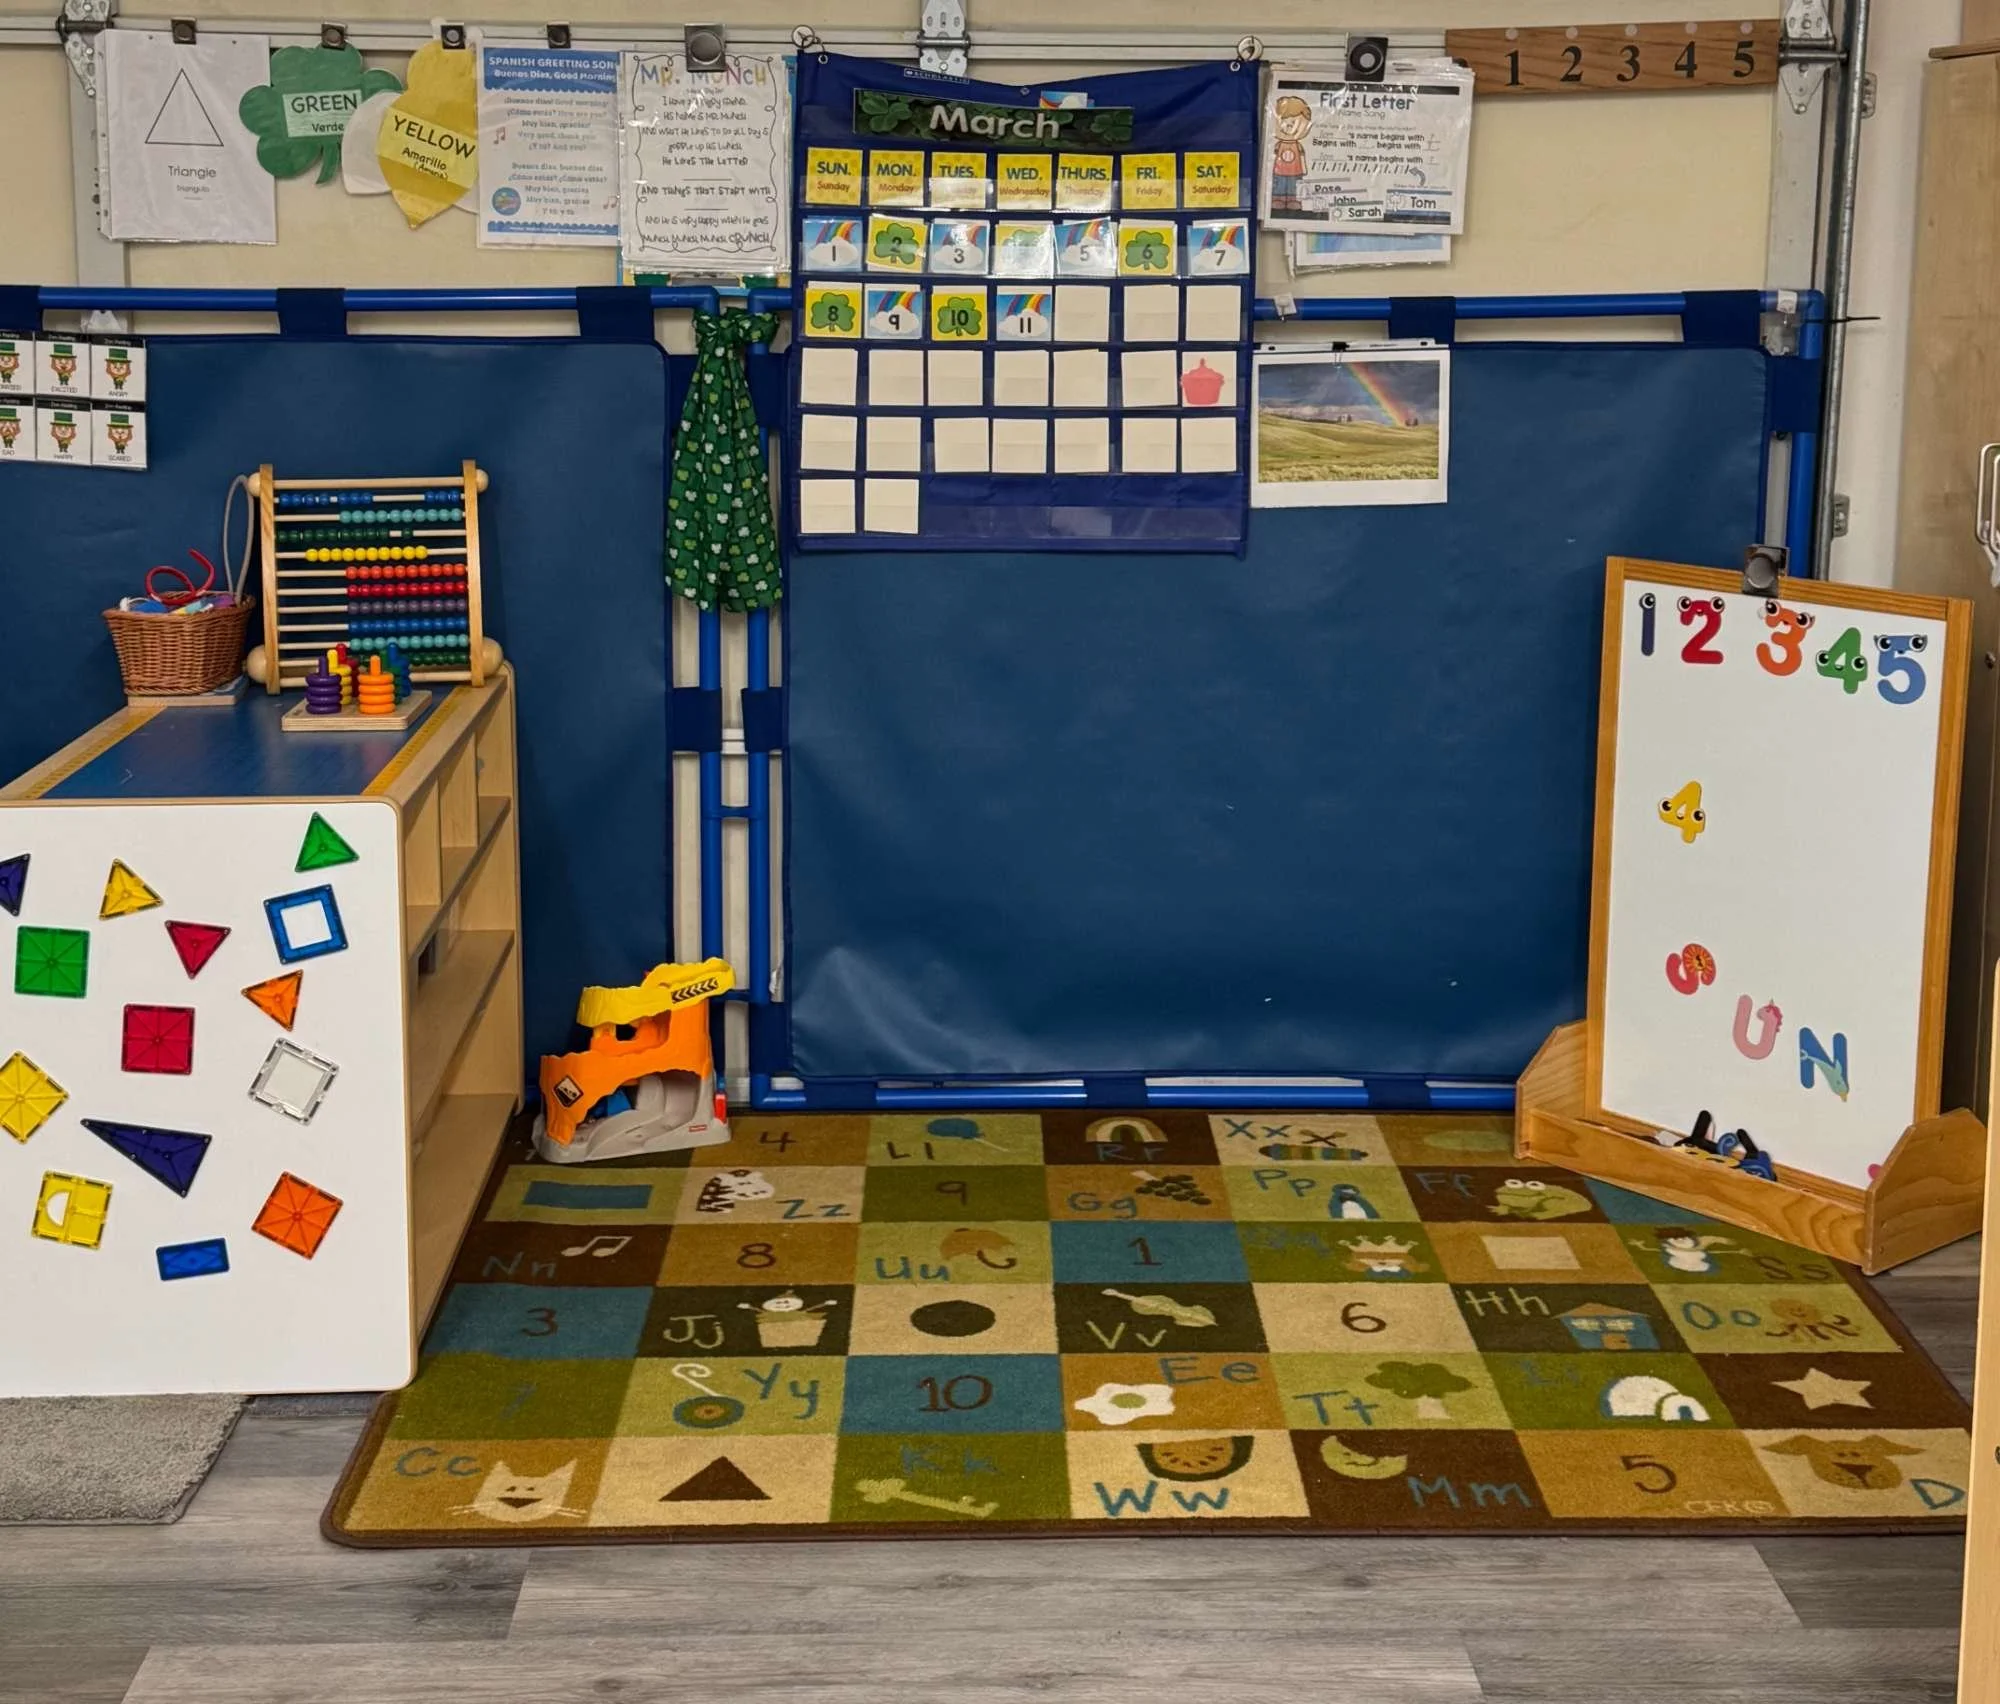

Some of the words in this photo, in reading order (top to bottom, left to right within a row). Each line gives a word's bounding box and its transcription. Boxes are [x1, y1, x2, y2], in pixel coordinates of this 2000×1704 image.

[489, 57, 536, 67] SPANISH
[537, 58, 590, 69] GREETING
[592, 60, 617, 70] SON
[1504, 50, 1524, 86] 1
[1560, 46, 1584, 82] 2
[1616, 45, 1641, 82] 3
[1674, 40, 1698, 78] 4
[1733, 40, 1755, 78] 5
[554, 71, 579, 80] Good
[291, 93, 358, 114] GREEN
[1319, 92, 1358, 109] First
[1362, 94, 1415, 110] Letter
[312, 122, 345, 133] Verde
[930, 104, 1060, 139] March
[395, 115, 476, 159] YELLOW
[1312, 138, 1338, 148] Begins
[1339, 139, 1357, 148] with
[1376, 140, 1402, 150] begins
[1403, 141, 1422, 150] with
[1356, 132, 1379, 141] name
[1380, 132, 1406, 142] begins
[1407, 133, 1425, 143] with
[402, 147, 447, 170] Amarillo
[1355, 154, 1378, 163] name
[1378, 154, 1405, 164] begins
[1406, 155, 1424, 165] with
[817, 161, 852, 176] SUN.
[876, 163, 916, 177] MON.
[940, 165, 978, 178] TUES.
[1006, 167, 1043, 180] WED.
[1060, 167, 1110, 182] THURS.
[1136, 167, 1161, 180] FRI.
[1196, 165, 1227, 179] SAT.
[817, 180, 850, 193] Sunday
[878, 183, 915, 194] Monday
[1000, 187, 1050, 198] Wednesday
[1136, 186, 1163, 197] Friday
[1192, 185, 1232, 196] Saturday
[1348, 207, 1382, 218] Sarah
[1411, 196, 1437, 209] Tom
[953, 248, 965, 264] 3
[1080, 245, 1089, 262] 5
[1142, 243, 1153, 261] 6
[1215, 249, 1226, 267] 7
[827, 305, 839, 322] 8
[951, 309, 969, 326] 10
[1019, 317, 1032, 334] 11
[1639, 592, 1656, 657] 1
[1676, 596, 1726, 665] 2
[1756, 599, 1815, 677] 3
[1815, 627, 1869, 695] 4
[1874, 633, 1928, 705] 5
[1658, 780, 1706, 843] 4
[759, 1131, 797, 1153] 4
[935, 1180, 968, 1205] 9
[736, 1242, 777, 1269] 8
[1129, 1237, 1163, 1266] 1
[520, 1307, 558, 1337] 3
[1340, 1302, 1387, 1334] 6
[917, 1375, 994, 1413] 10
[1620, 1455, 1677, 1494] 5
[1909, 1478, 1966, 1511] D
